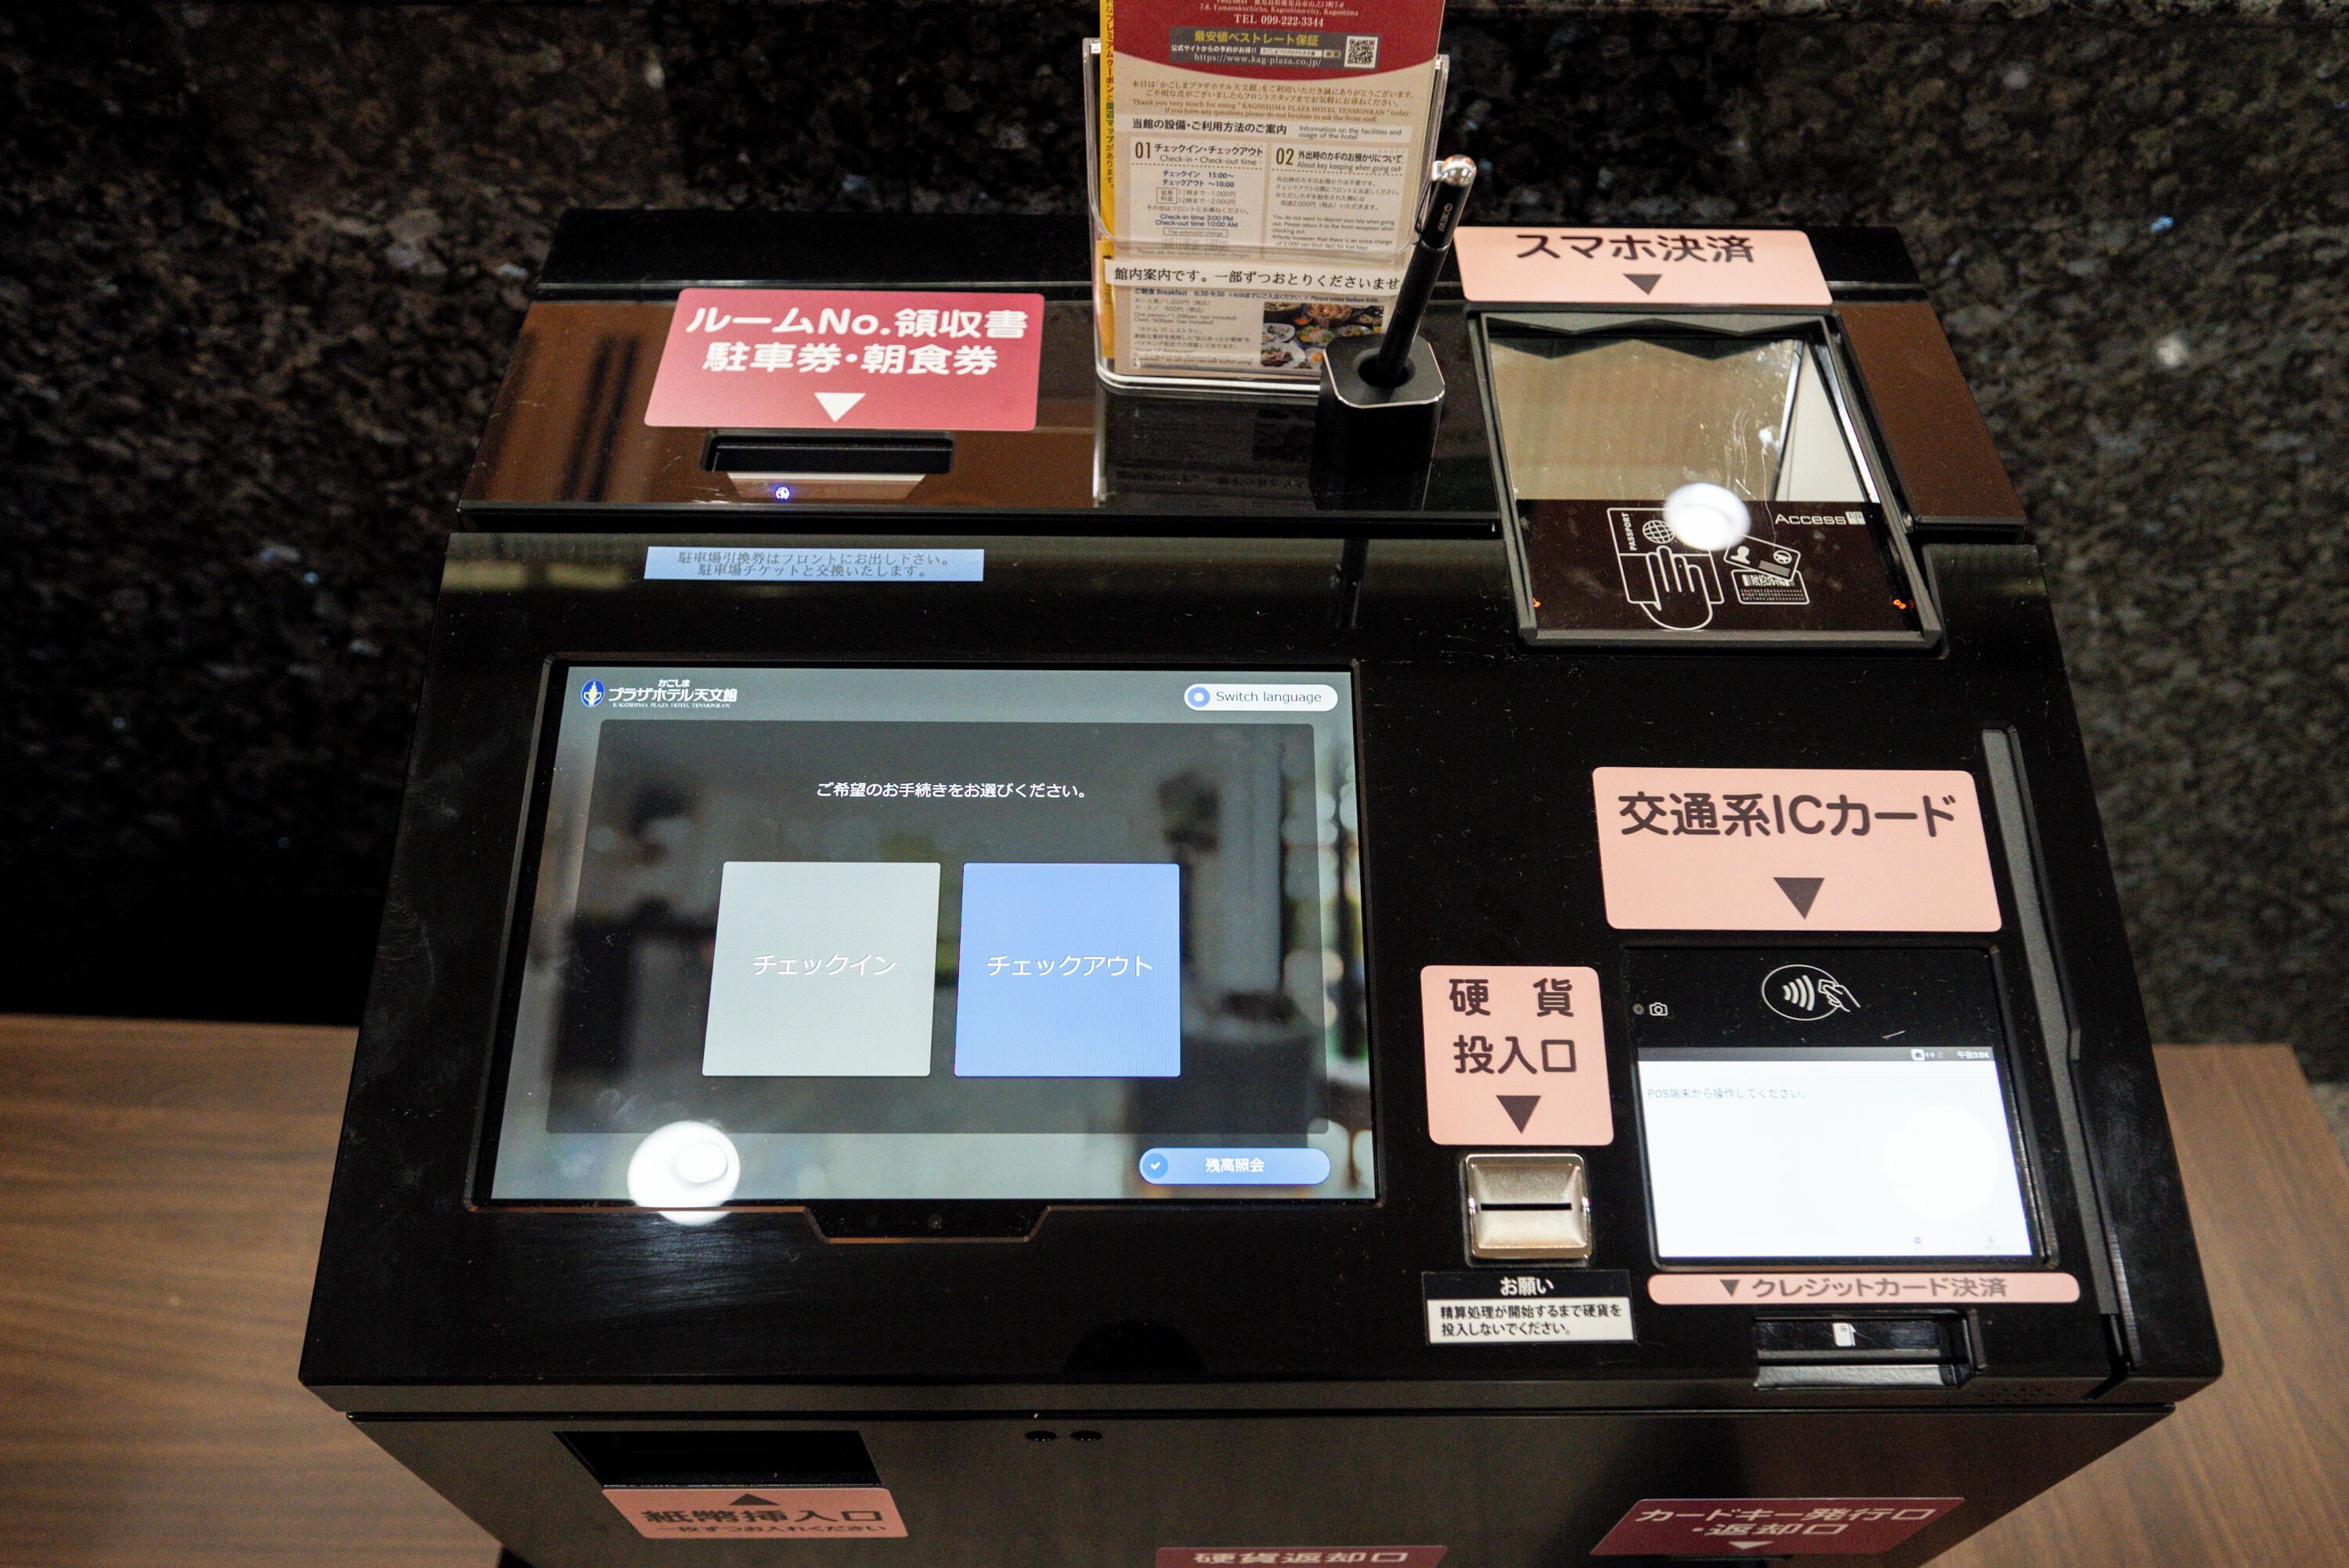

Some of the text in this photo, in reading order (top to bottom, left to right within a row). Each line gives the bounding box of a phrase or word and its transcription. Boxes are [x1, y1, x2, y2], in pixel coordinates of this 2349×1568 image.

[1234, 14, 1324, 27] TEL 099-222-3344
[1194, 30, 1319, 46] 最安値ベストレート保証
[1194, 52, 1322, 67] https://www.kag-plaza.co.jp/
[1243, 103, 1285, 112] KAGOSHIMA
[1338, 107, 1384, 116] TENMONKAN
[1132, 118, 1286, 135] 当館の設備・ご利用方法のご案内
[1300, 125, 1337, 134] Information
[1135, 142, 1151, 159] 01
[1154, 144, 1263, 157] チェックイン・チェックアウト
[1276, 147, 1294, 165] 02
[1298, 150, 1402, 164] 外出時のカギのお預かりについて
[1200, 156, 1238, 164] Check-out
[1330, 163, 1353, 172] keeping
[1372, 164, 1388, 173] going
[1162, 178, 1204, 187] チェックアウト
[1517, 233, 1755, 263] スマホ決済
[686, 307, 1028, 339] ルームNo.領収書
[702, 341, 998, 376] 駐車券・朝食券
[1622, 513, 1637, 551] PASSPORT
[677, 551, 950, 565] 駐車場引換券はフロントにお出し下さい。
[698, 563, 926, 578] 駐車場チケットと交換いたします。
[658, 679, 691, 687] かごしま
[608, 687, 738, 702] プラザホテル天文館
[1216, 690, 1322, 705] Switch language
[817, 781, 1086, 798] ご希望のお手続きをお選びください。
[1618, 791, 1956, 838] 交通系ICカード
[752, 953, 897, 976] チェックイン
[987, 954, 1153, 977] チェックアウト
[1453, 1034, 1576, 1075] 投入口
[1647, 1088, 1807, 1099] POS端末から操作してください。
[1205, 1157, 1265, 1173] 残高照会
[1499, 1276, 1554, 1296] お願い
[1752, 1278, 2008, 1299] クレジットカード決済
[1440, 1304, 1622, 1320] 精算処理が開始するまで硬貨を
[1442, 1321, 1571, 1337] 投入しないでください。
[641, 1509, 883, 1523] 紙幣挿入口
[1635, 1508, 1936, 1523] カードキー発行口
[1193, 1552, 1409, 1565] 硬貨返却口
